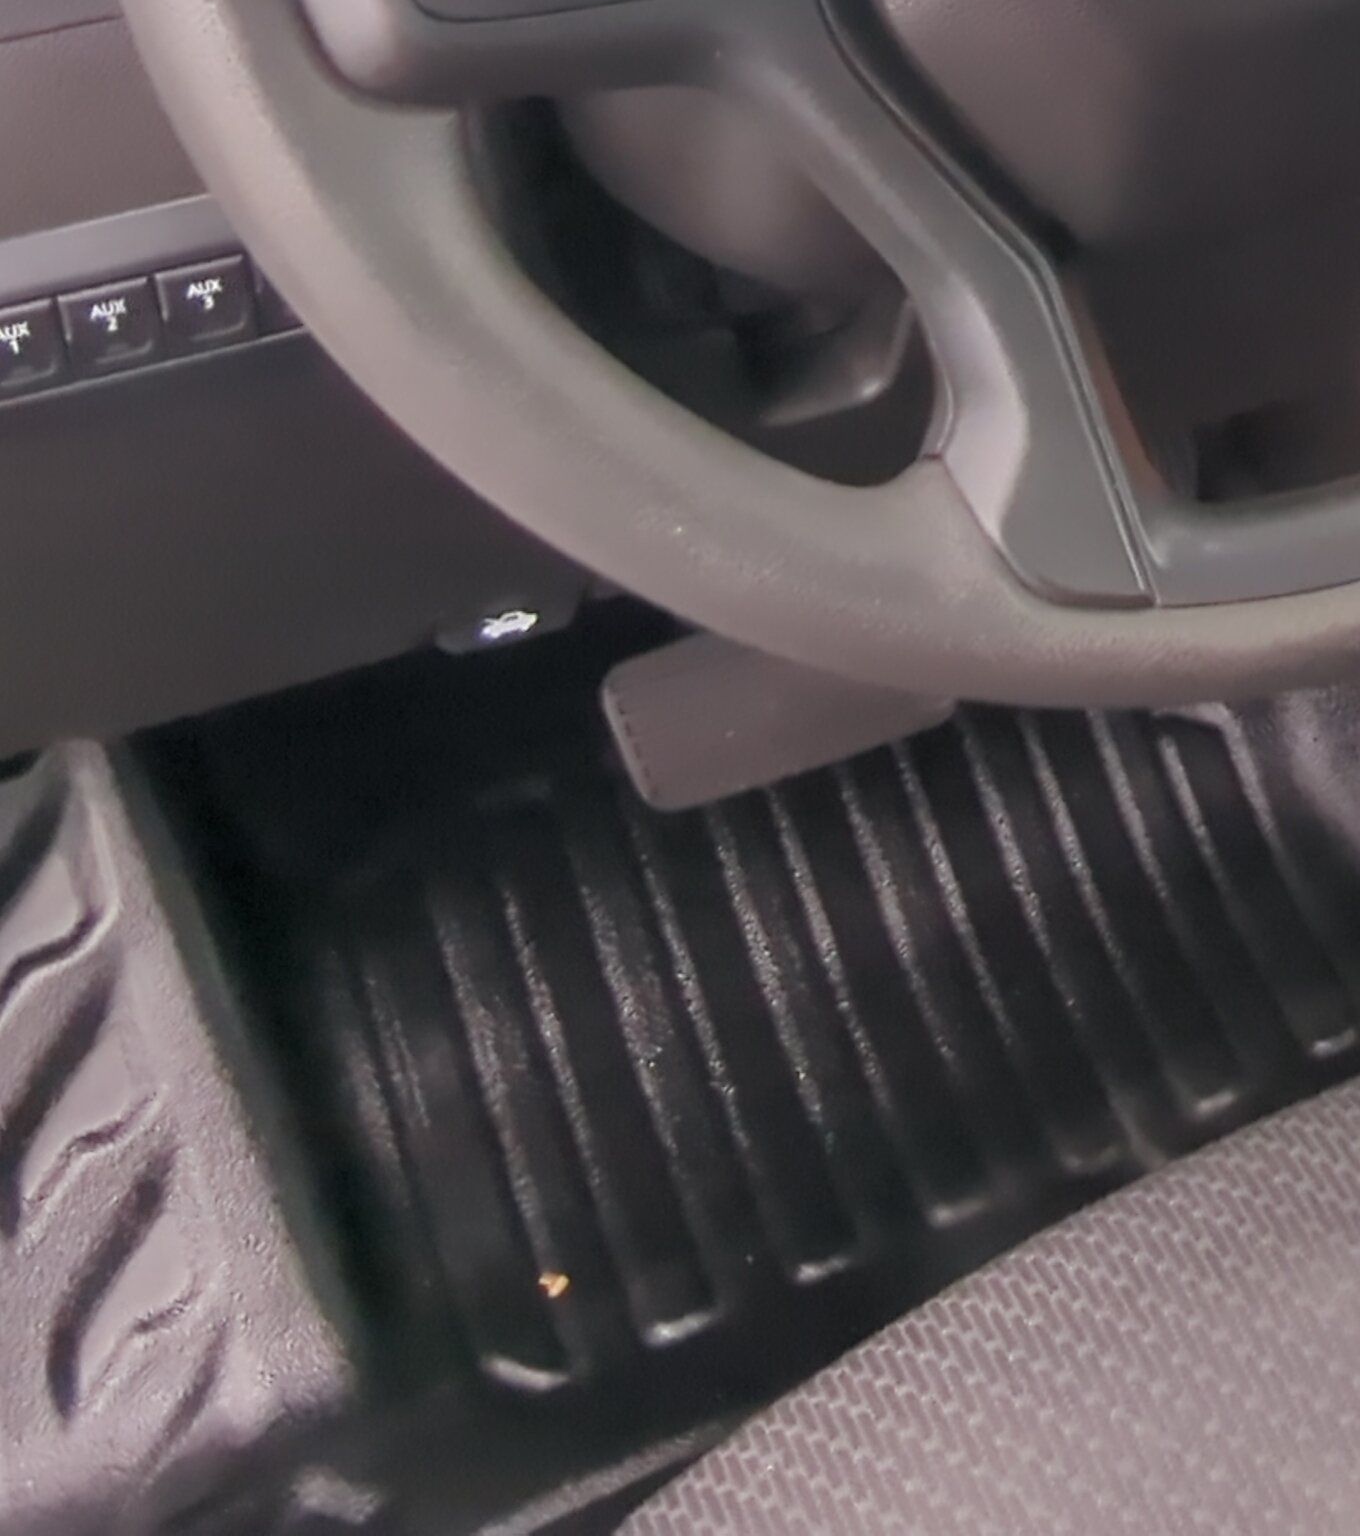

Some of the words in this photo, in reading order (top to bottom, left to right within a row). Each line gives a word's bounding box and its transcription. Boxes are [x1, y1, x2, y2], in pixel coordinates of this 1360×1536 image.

[186, 277, 223, 299] AUX
[89, 298, 127, 320] AUX
[203, 295, 215, 311] 3
[107, 317, 118, 332] 2
[9, 339, 20, 354] 1
